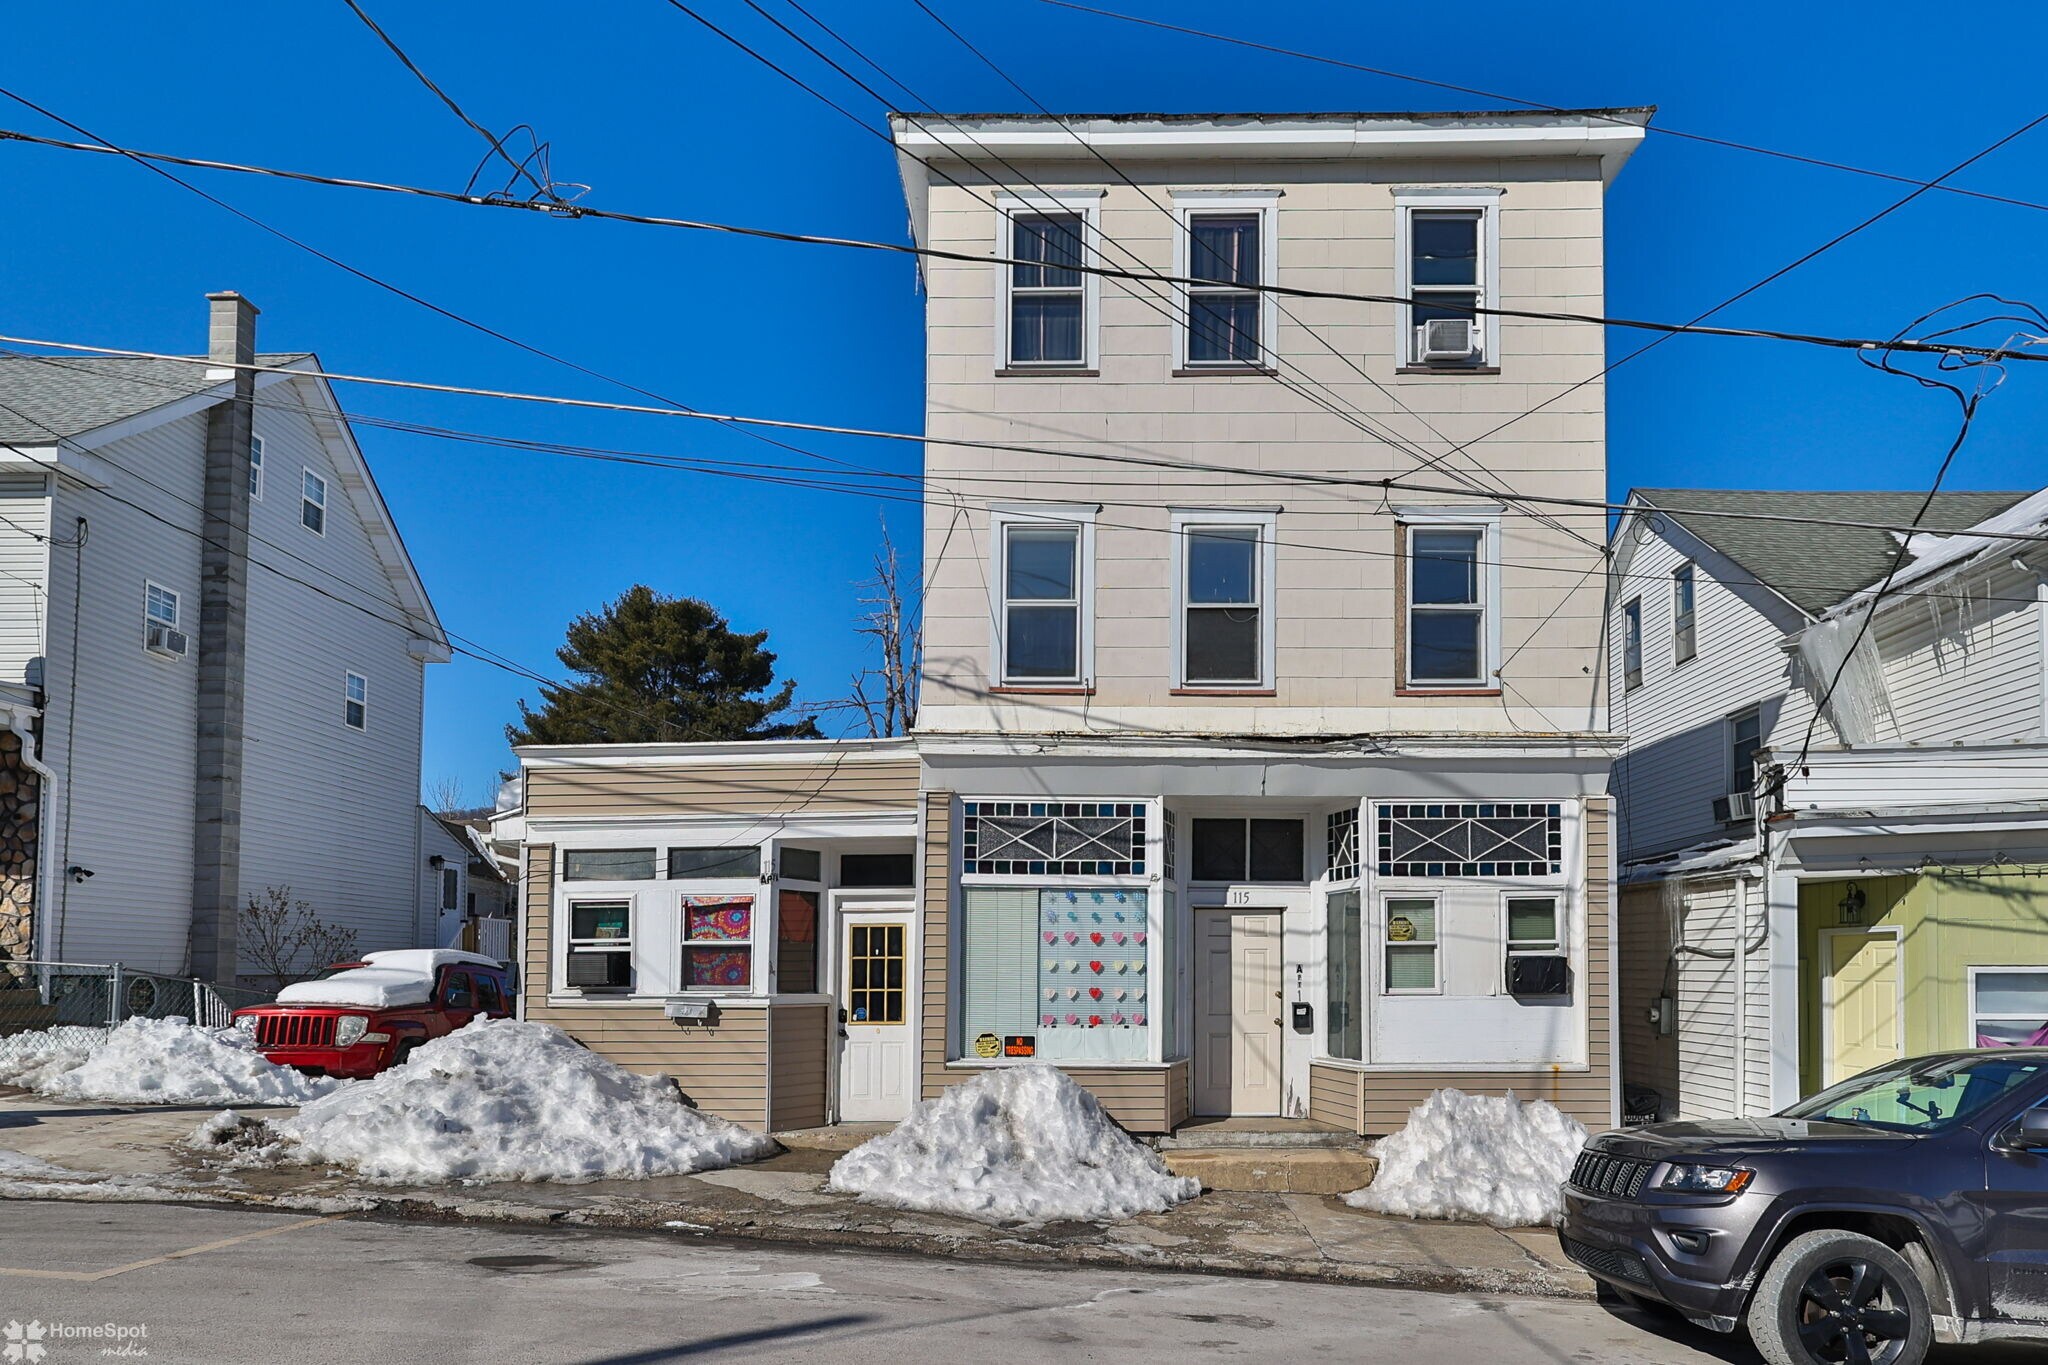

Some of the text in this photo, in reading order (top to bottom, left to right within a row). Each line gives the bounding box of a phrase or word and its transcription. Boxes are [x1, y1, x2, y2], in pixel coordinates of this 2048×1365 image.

[1233, 891, 1250, 904] 115
[1016, 1037, 1024, 1046] NO
[1005, 1046, 1034, 1055] TRESPASSING
